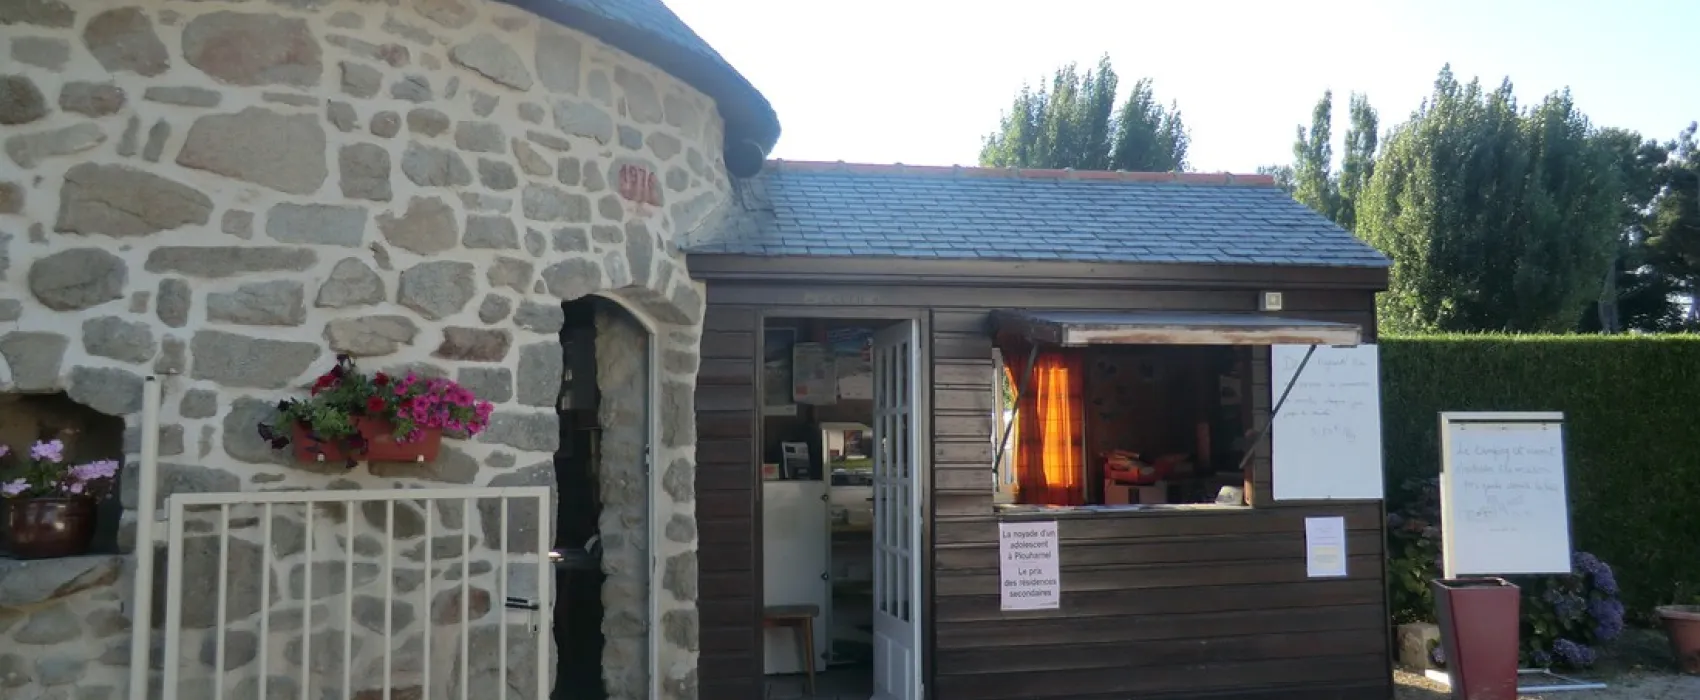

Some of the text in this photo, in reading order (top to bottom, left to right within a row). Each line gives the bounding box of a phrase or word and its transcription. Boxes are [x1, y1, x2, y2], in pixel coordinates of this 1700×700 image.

[1002, 529, 1056, 538] La noyade d'un
[1010, 540, 1049, 549] adolescent
[1014, 550, 1051, 560] Plouharnel
[1018, 567, 1042, 576] Le prix
[1004, 577, 1057, 587] des résidences
[1009, 589, 1052, 598] secondaires
